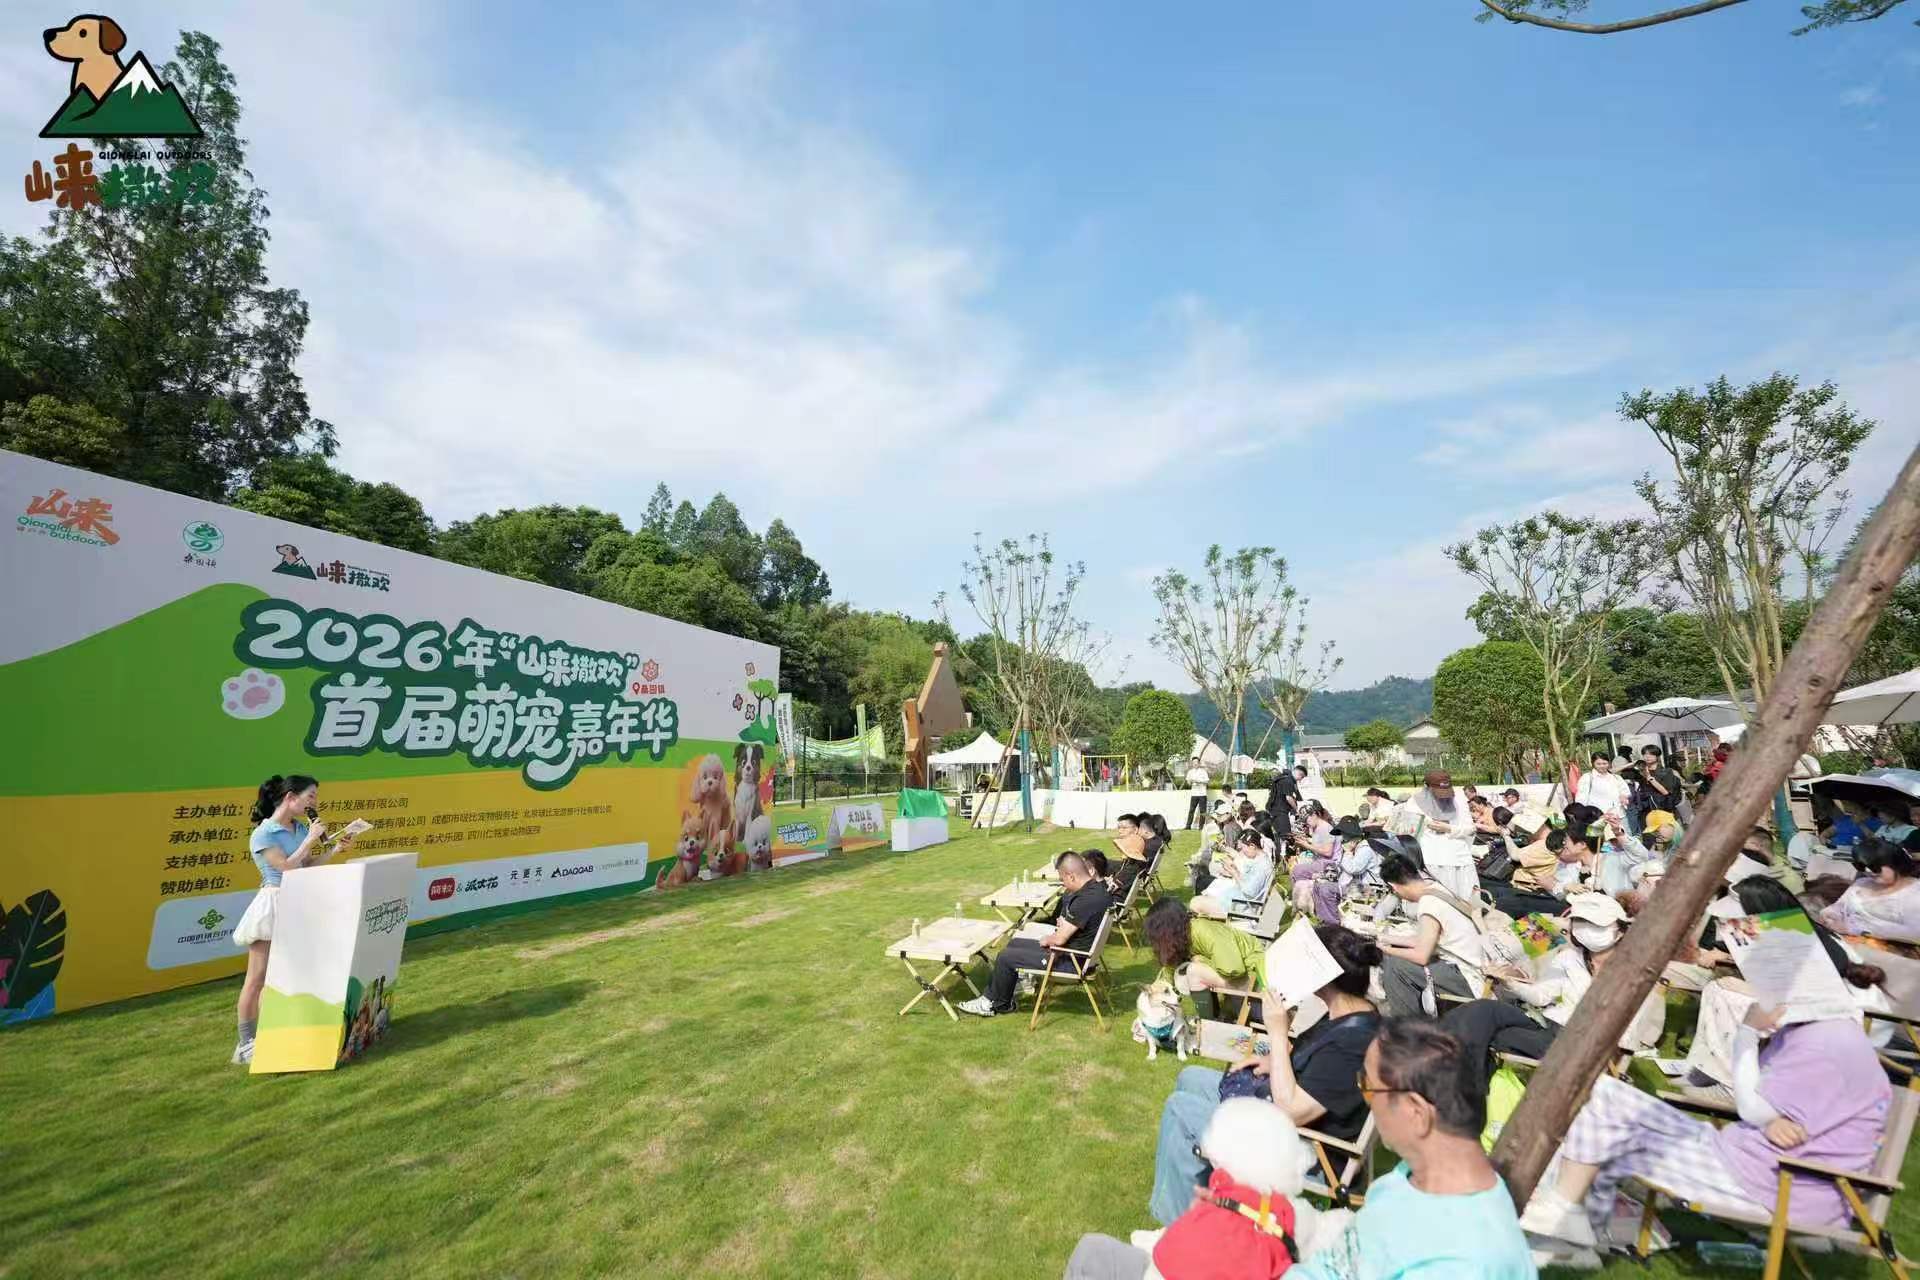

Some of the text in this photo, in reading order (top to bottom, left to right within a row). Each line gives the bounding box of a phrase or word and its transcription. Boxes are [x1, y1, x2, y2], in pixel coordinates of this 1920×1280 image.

[312, 671, 674, 783] 首届萌宠嘉年华
[173, 803, 243, 819] 主办单位：
[168, 828, 239, 844] 承办单位：
[164, 851, 234, 870] 支持单位：
[161, 877, 231, 896] 赞助单位：
